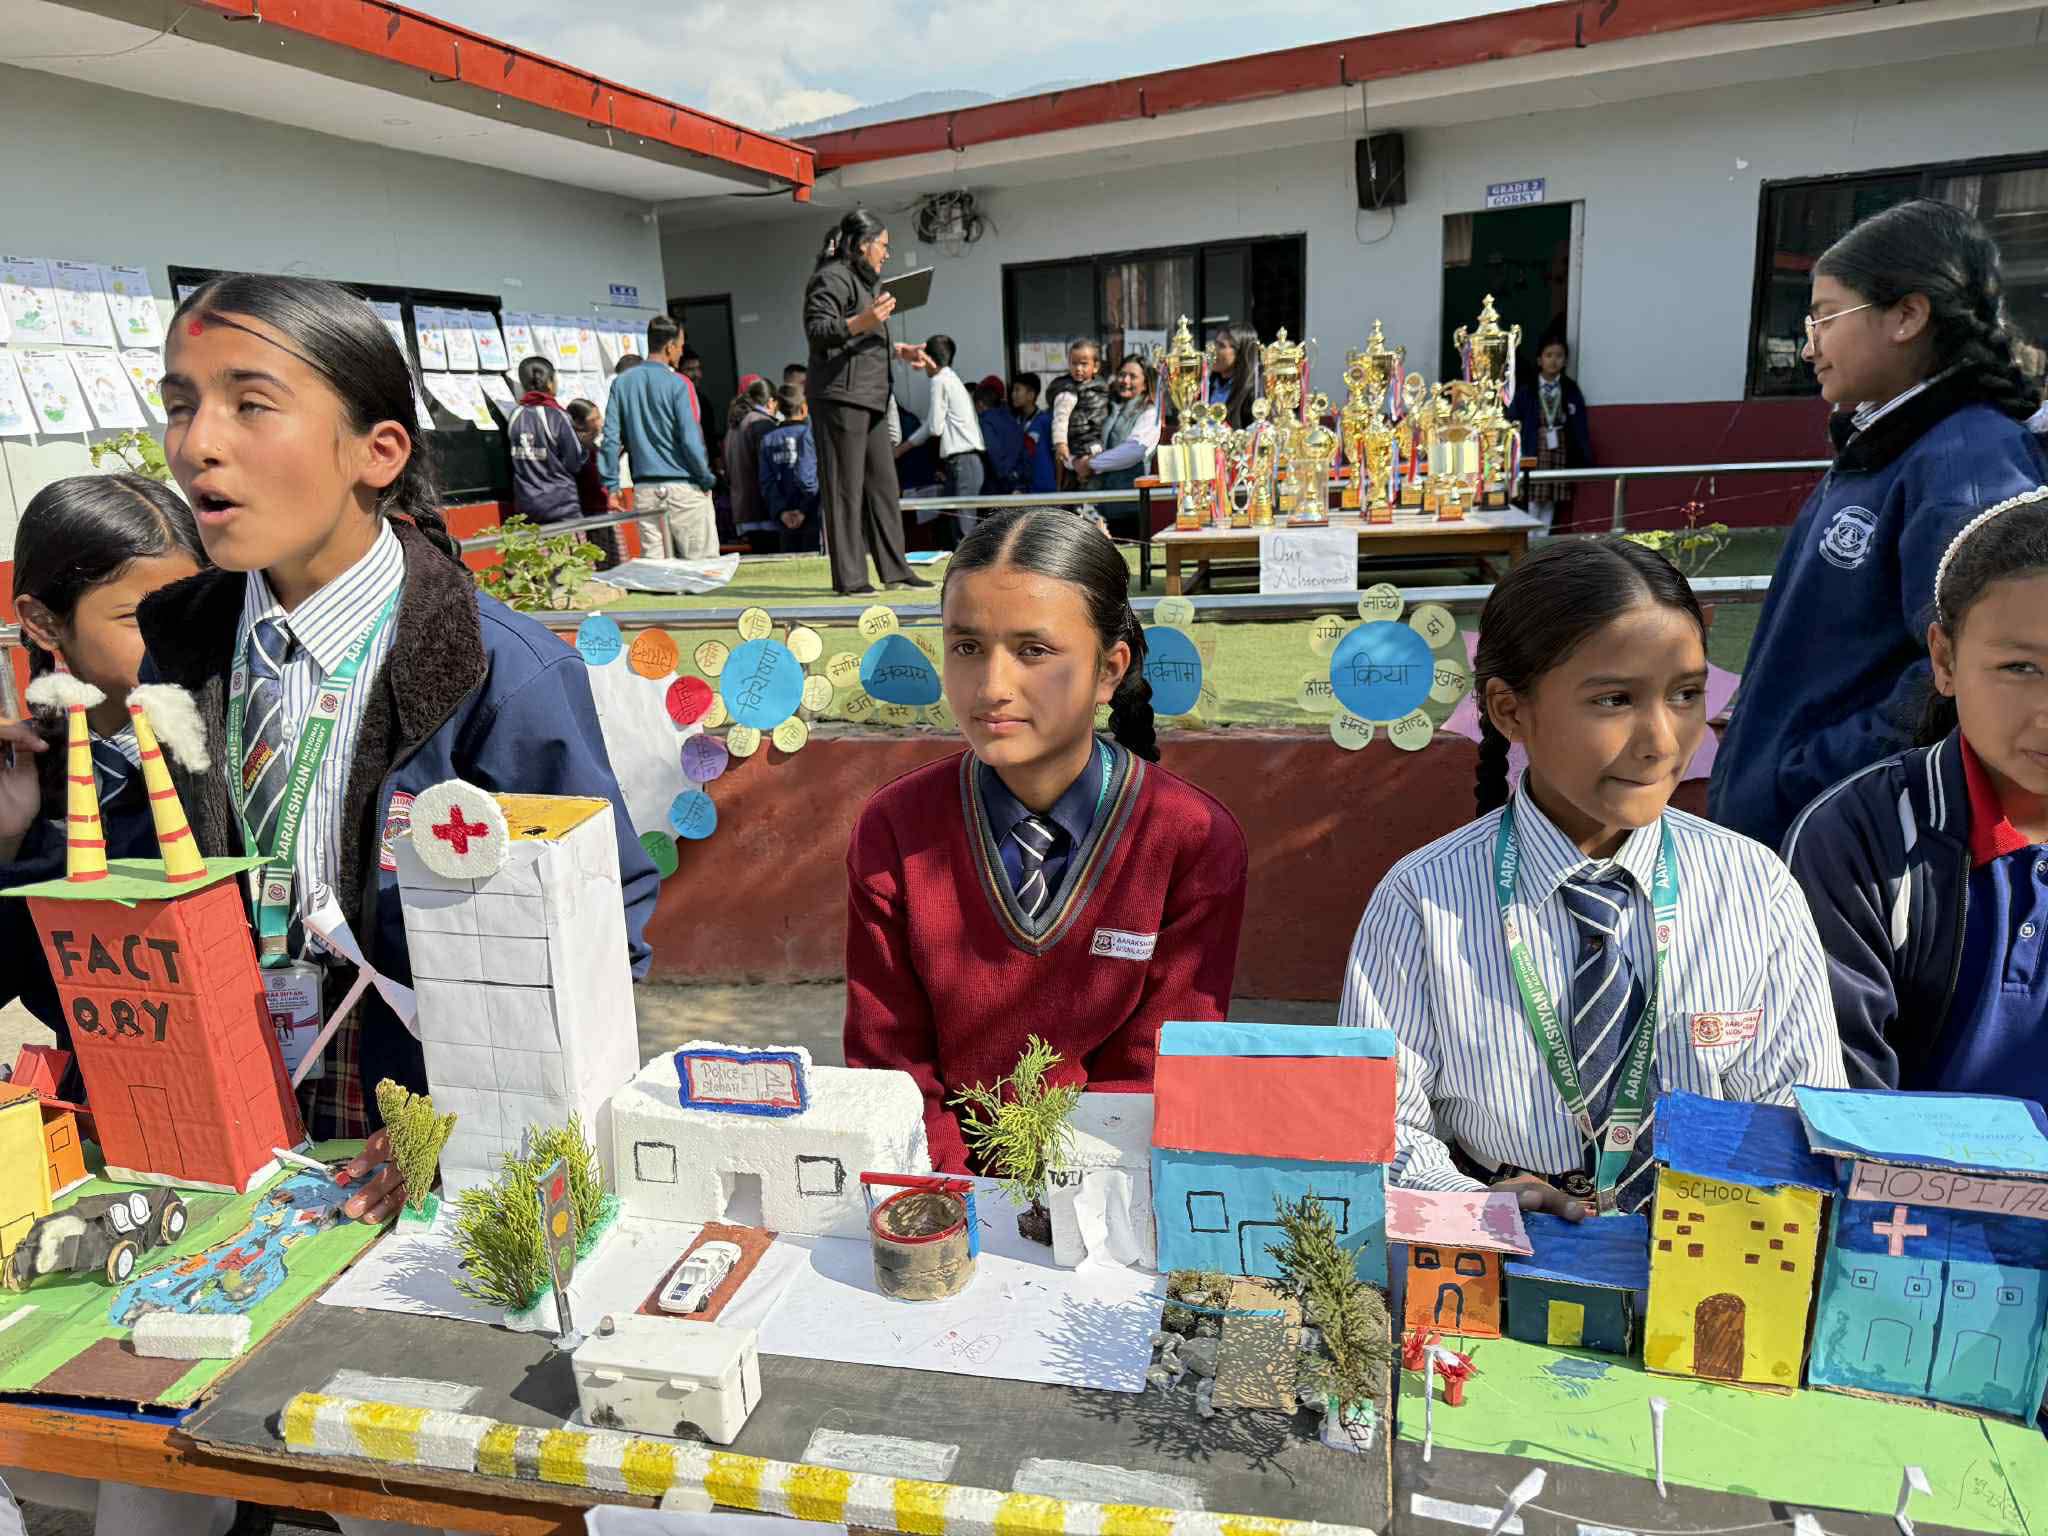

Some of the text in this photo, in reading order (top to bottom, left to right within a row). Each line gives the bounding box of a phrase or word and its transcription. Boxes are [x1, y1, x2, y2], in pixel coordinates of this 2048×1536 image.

[303, 721, 321, 761] NATIONAL
[311, 726, 326, 767] ACADEMY
[277, 765, 312, 862] AARAKSHYAN
[51, 930, 182, 984] FACT
[1531, 990, 1577, 1088] AARAKSHYAN
[1624, 1002, 1657, 1100] AARAKSHYAN
[1676, 1179, 1761, 1205] SCHOOL
[1855, 1165, 2048, 1213] HOSPITAL
